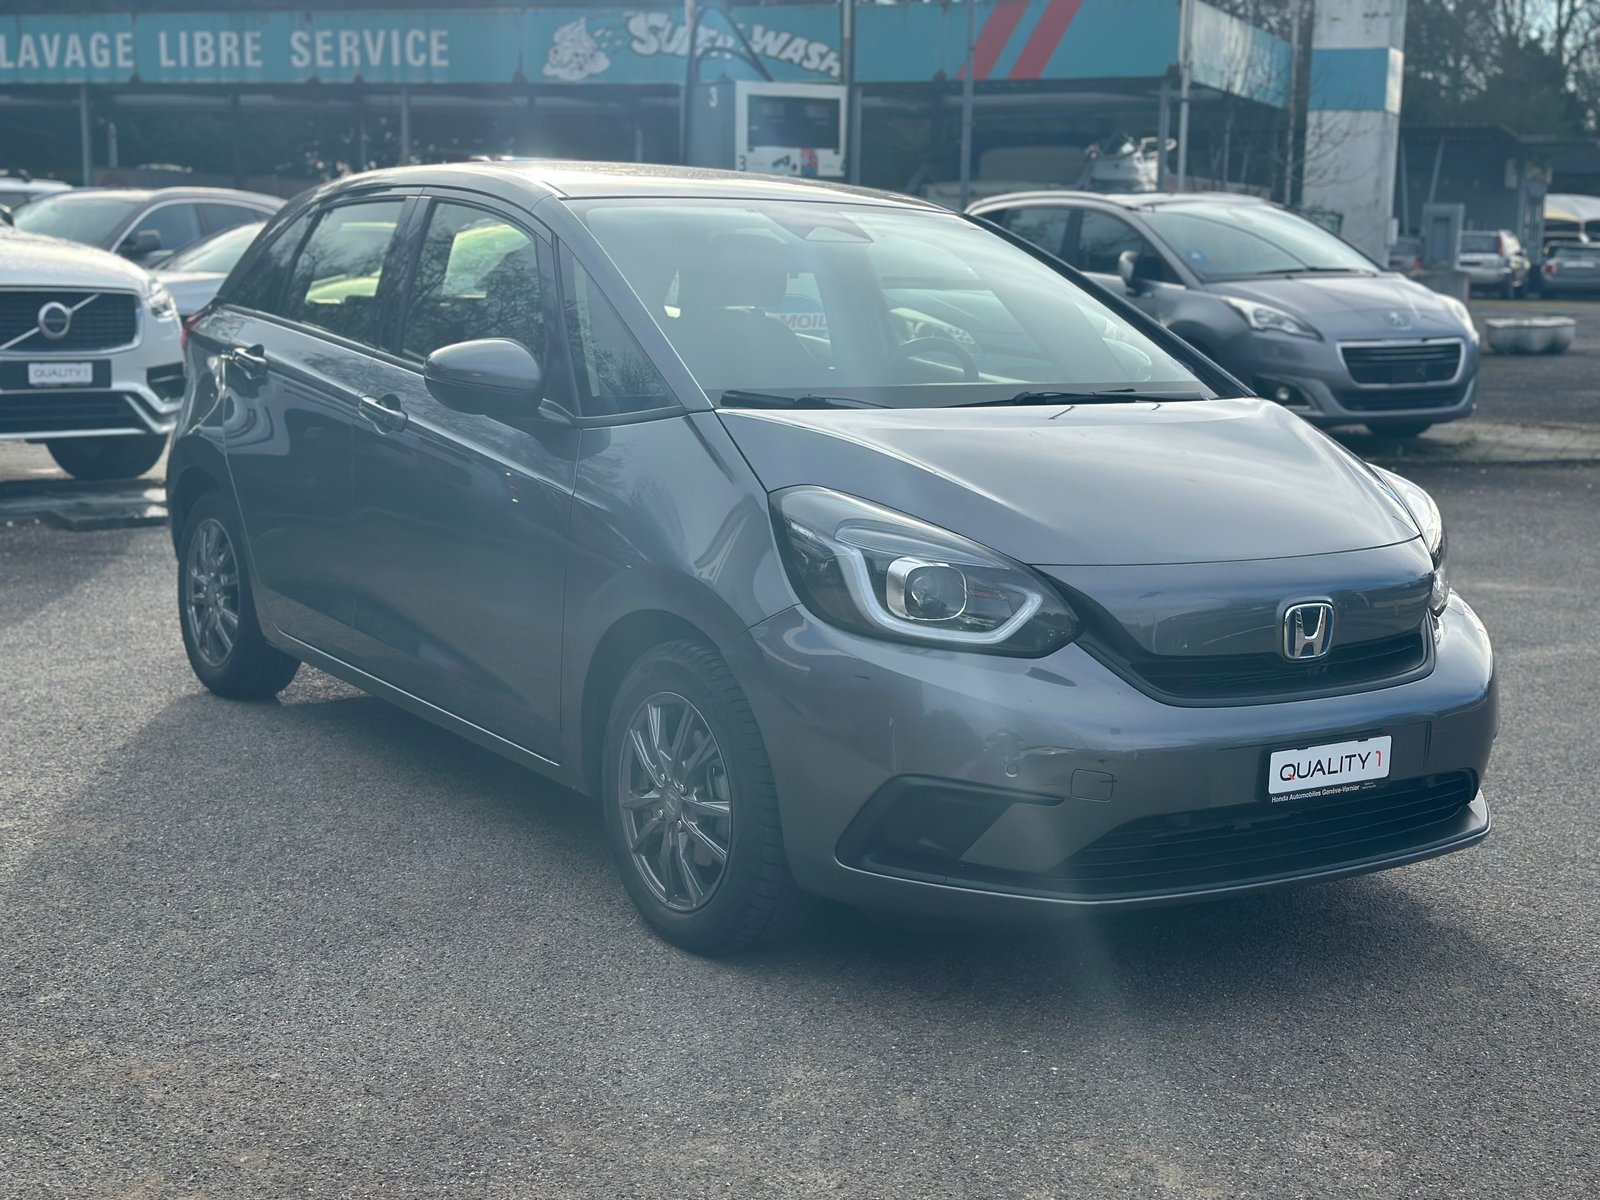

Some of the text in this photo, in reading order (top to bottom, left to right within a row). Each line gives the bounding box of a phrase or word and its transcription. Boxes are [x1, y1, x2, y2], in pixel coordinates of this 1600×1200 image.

[0, 29, 450, 69] LAVAGE LIBRE SERVICE
[33, 367, 81, 378] QUALITY
[1280, 750, 1383, 782] QUALITY 1
[1271, 795, 1289, 804] Honda
[1289, 790, 1322, 801] Automobiles
